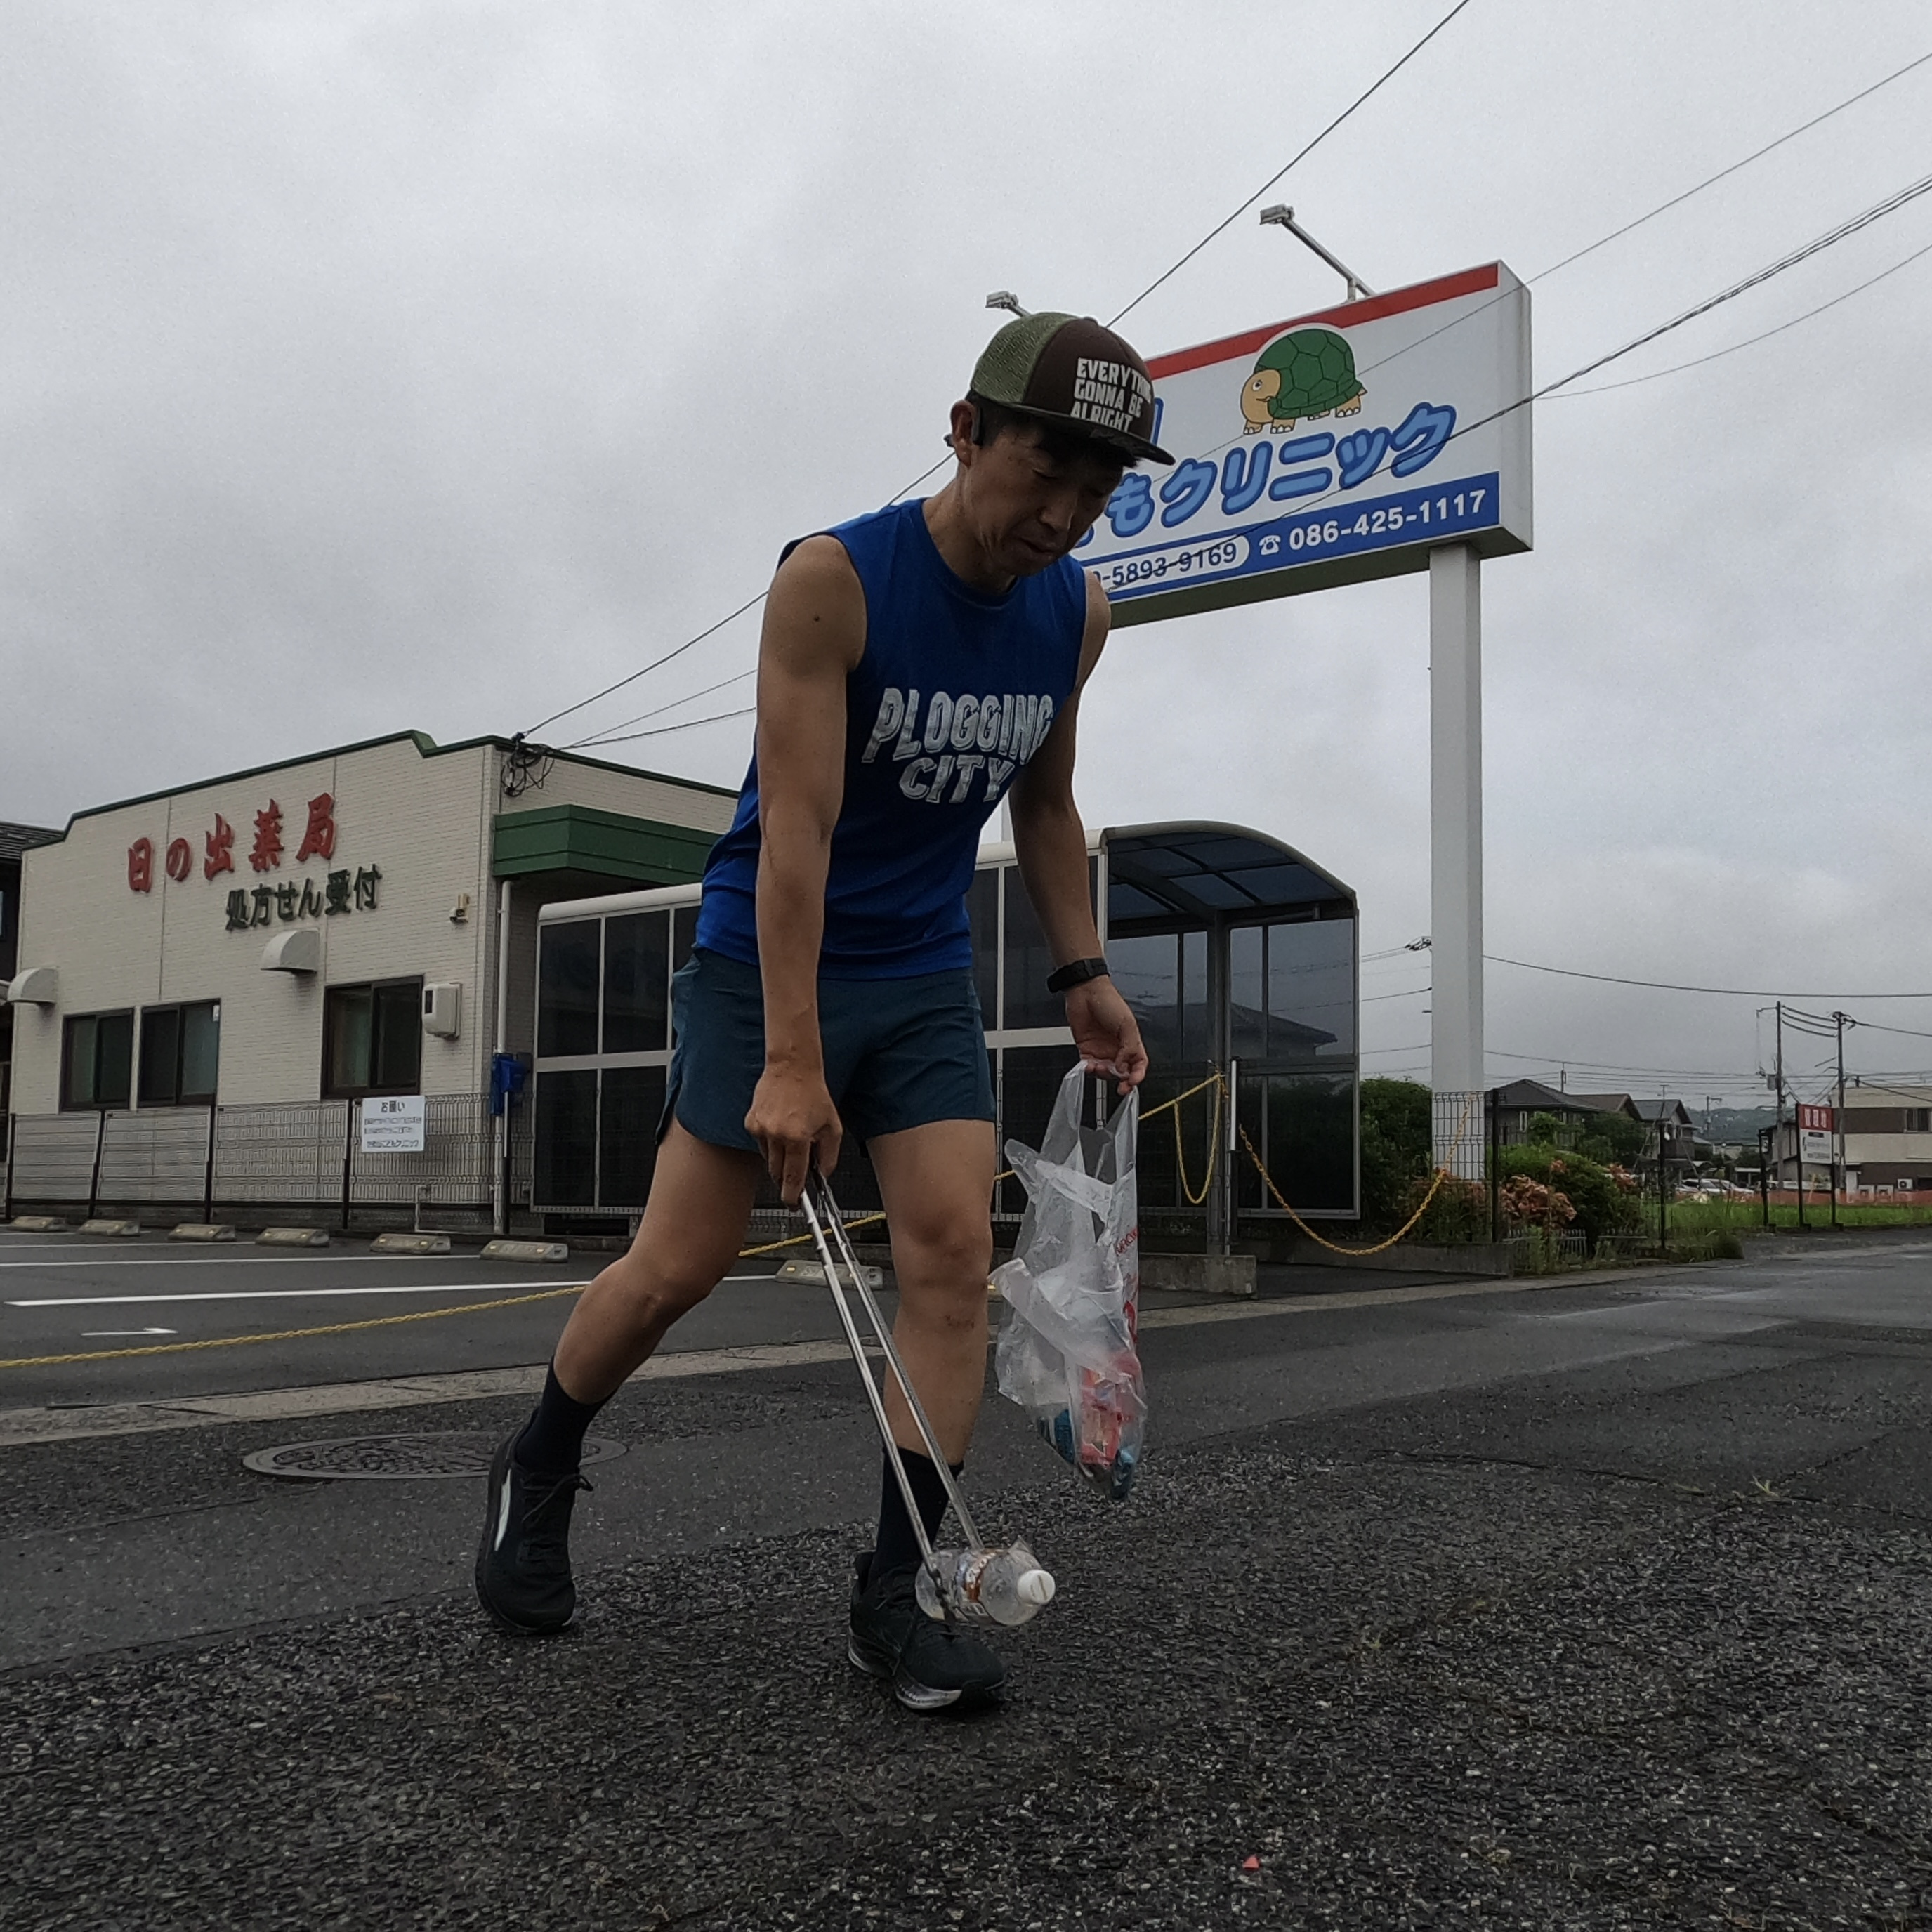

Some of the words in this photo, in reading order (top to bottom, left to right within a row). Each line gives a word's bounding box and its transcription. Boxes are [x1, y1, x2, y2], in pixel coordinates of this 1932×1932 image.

[1071, 401, 1133, 432] ALRIGHT
[1074, 378, 1124, 410] GONNA
[1128, 393, 1143, 418] BE
[1072, 401, 1457, 548] もクリニック
[1289, 489, 1486, 550] 086-425-1117
[861, 688, 1053, 765] PLOGGING
[899, 754, 1015, 803] CITY
[128, 793, 336, 893] 日の出薬局
[225, 864, 382, 931] 処方せん受付
